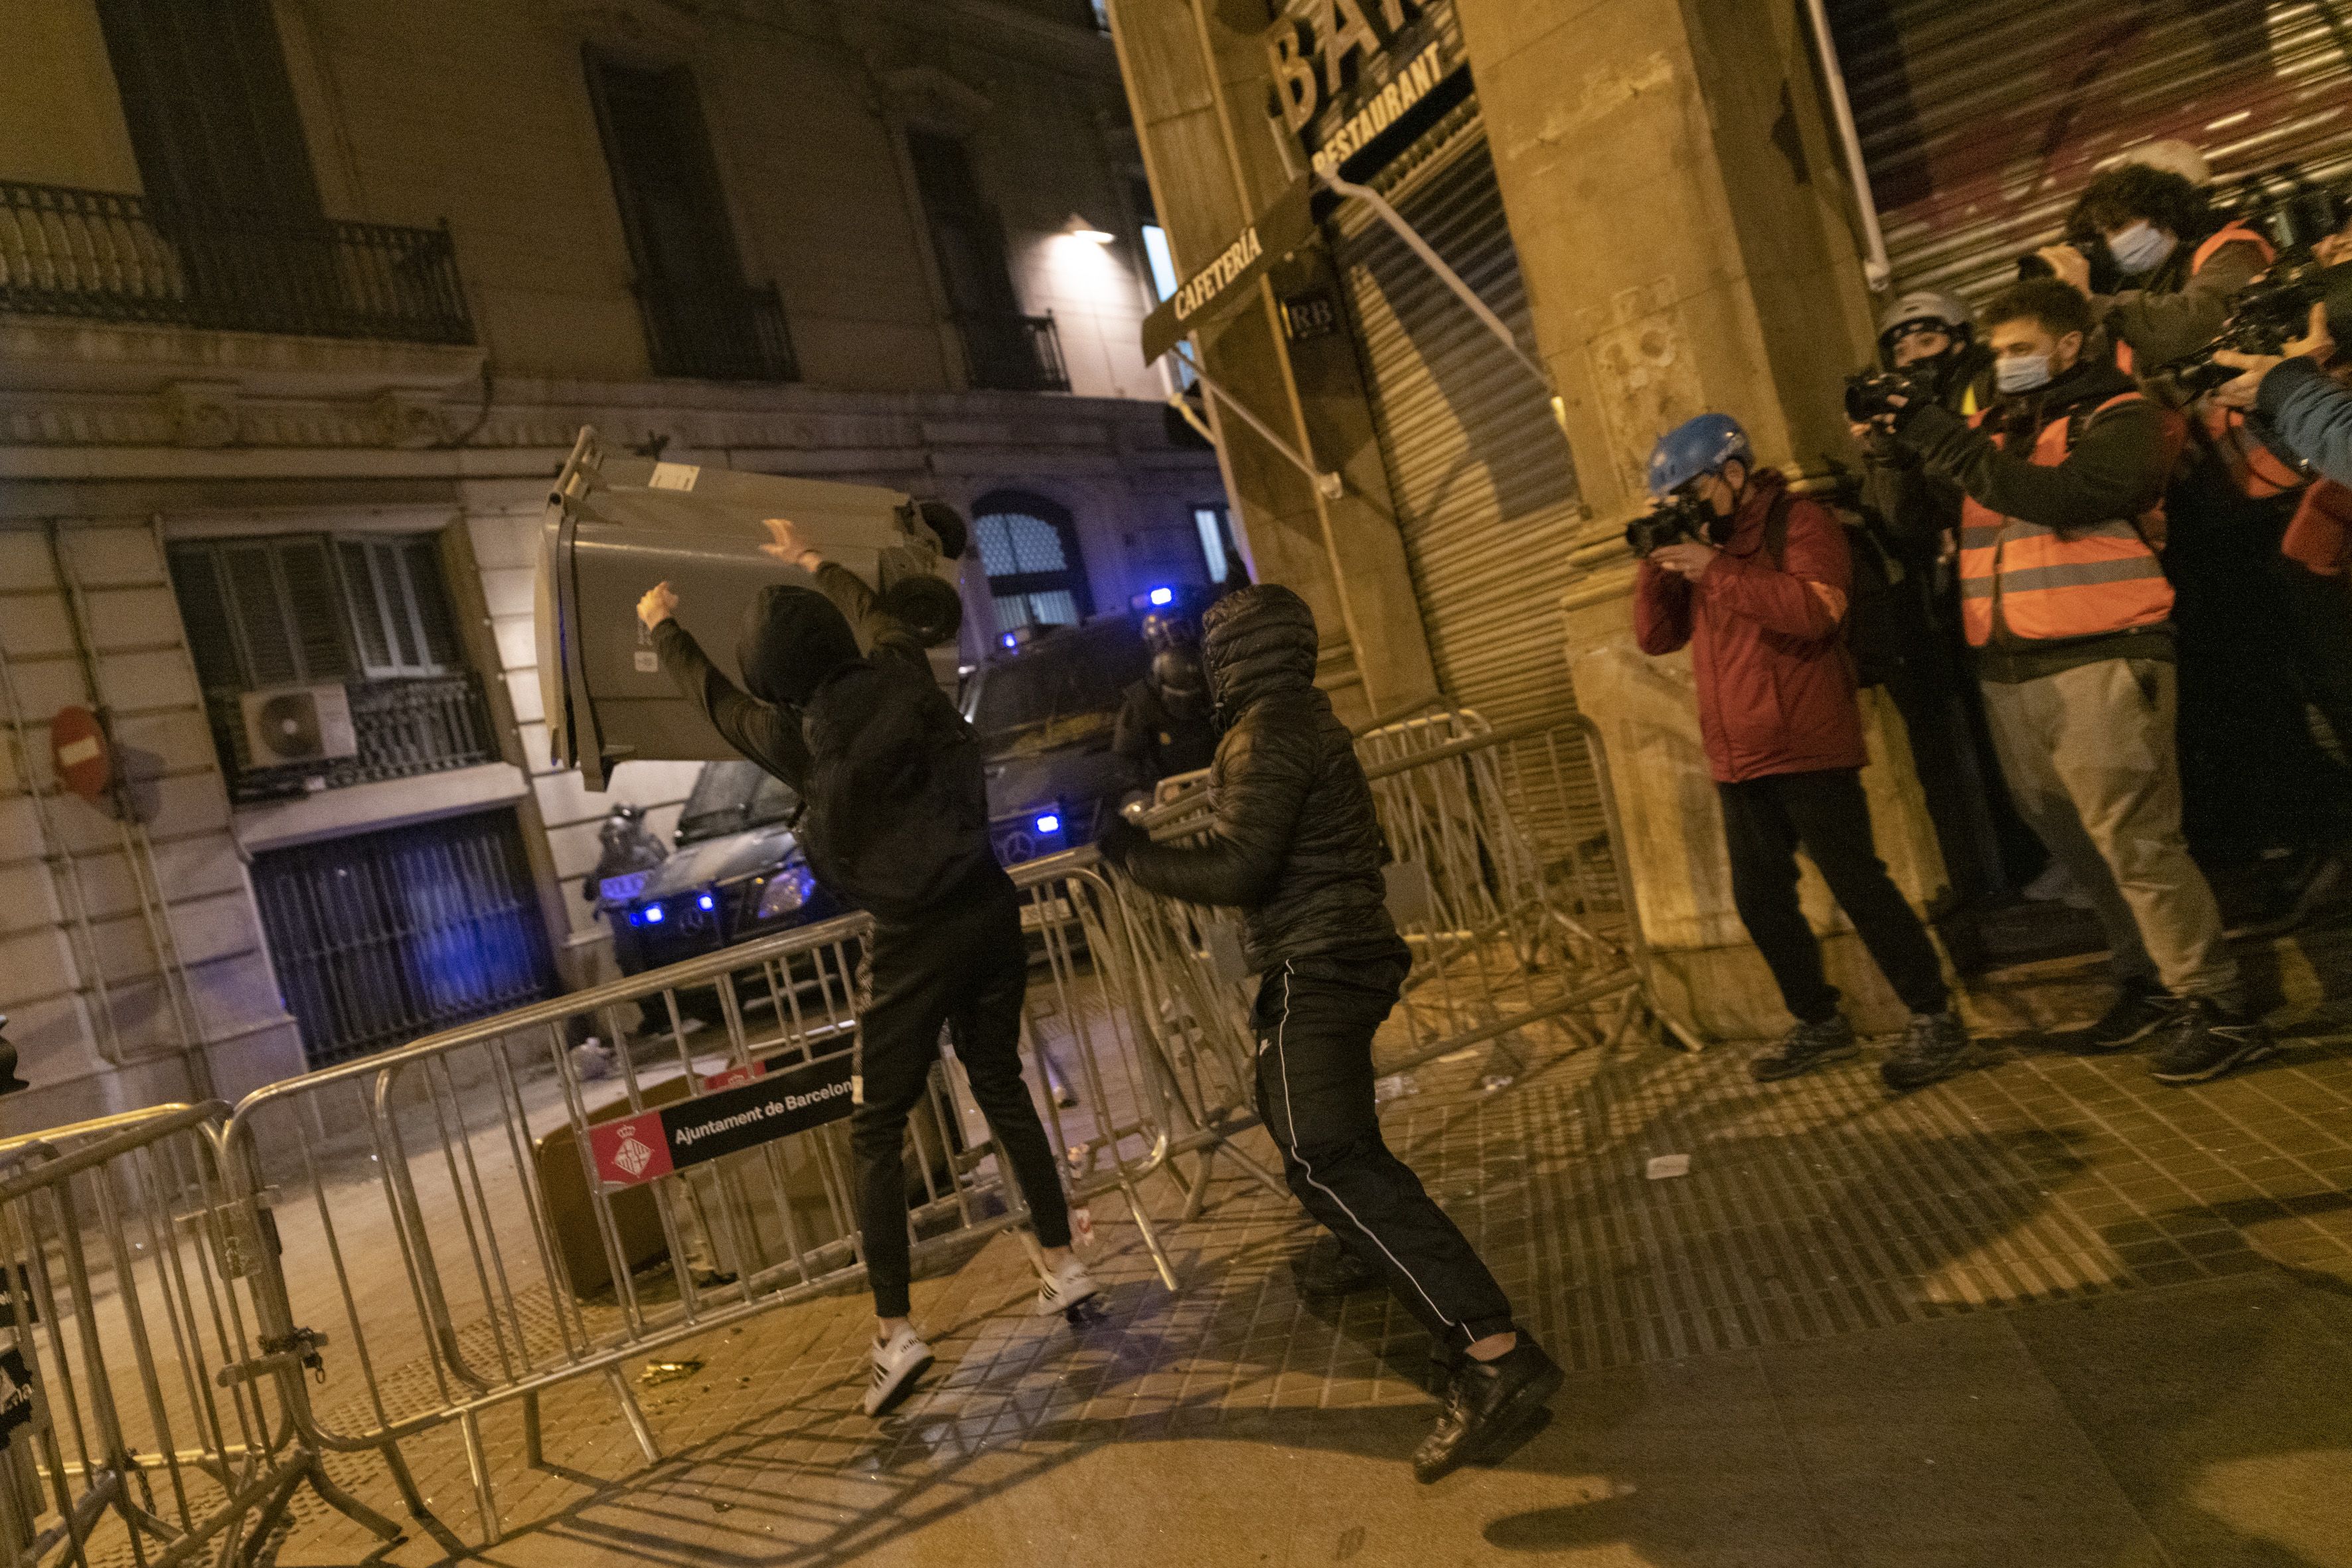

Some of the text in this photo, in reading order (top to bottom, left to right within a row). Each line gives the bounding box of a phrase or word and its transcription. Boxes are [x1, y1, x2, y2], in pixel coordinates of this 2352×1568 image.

[1263, 0, 1427, 133] BA
[1312, 40, 1442, 173] RESTAURANT
[675, 1081, 853, 1145] Ajuntament de Barcelon
